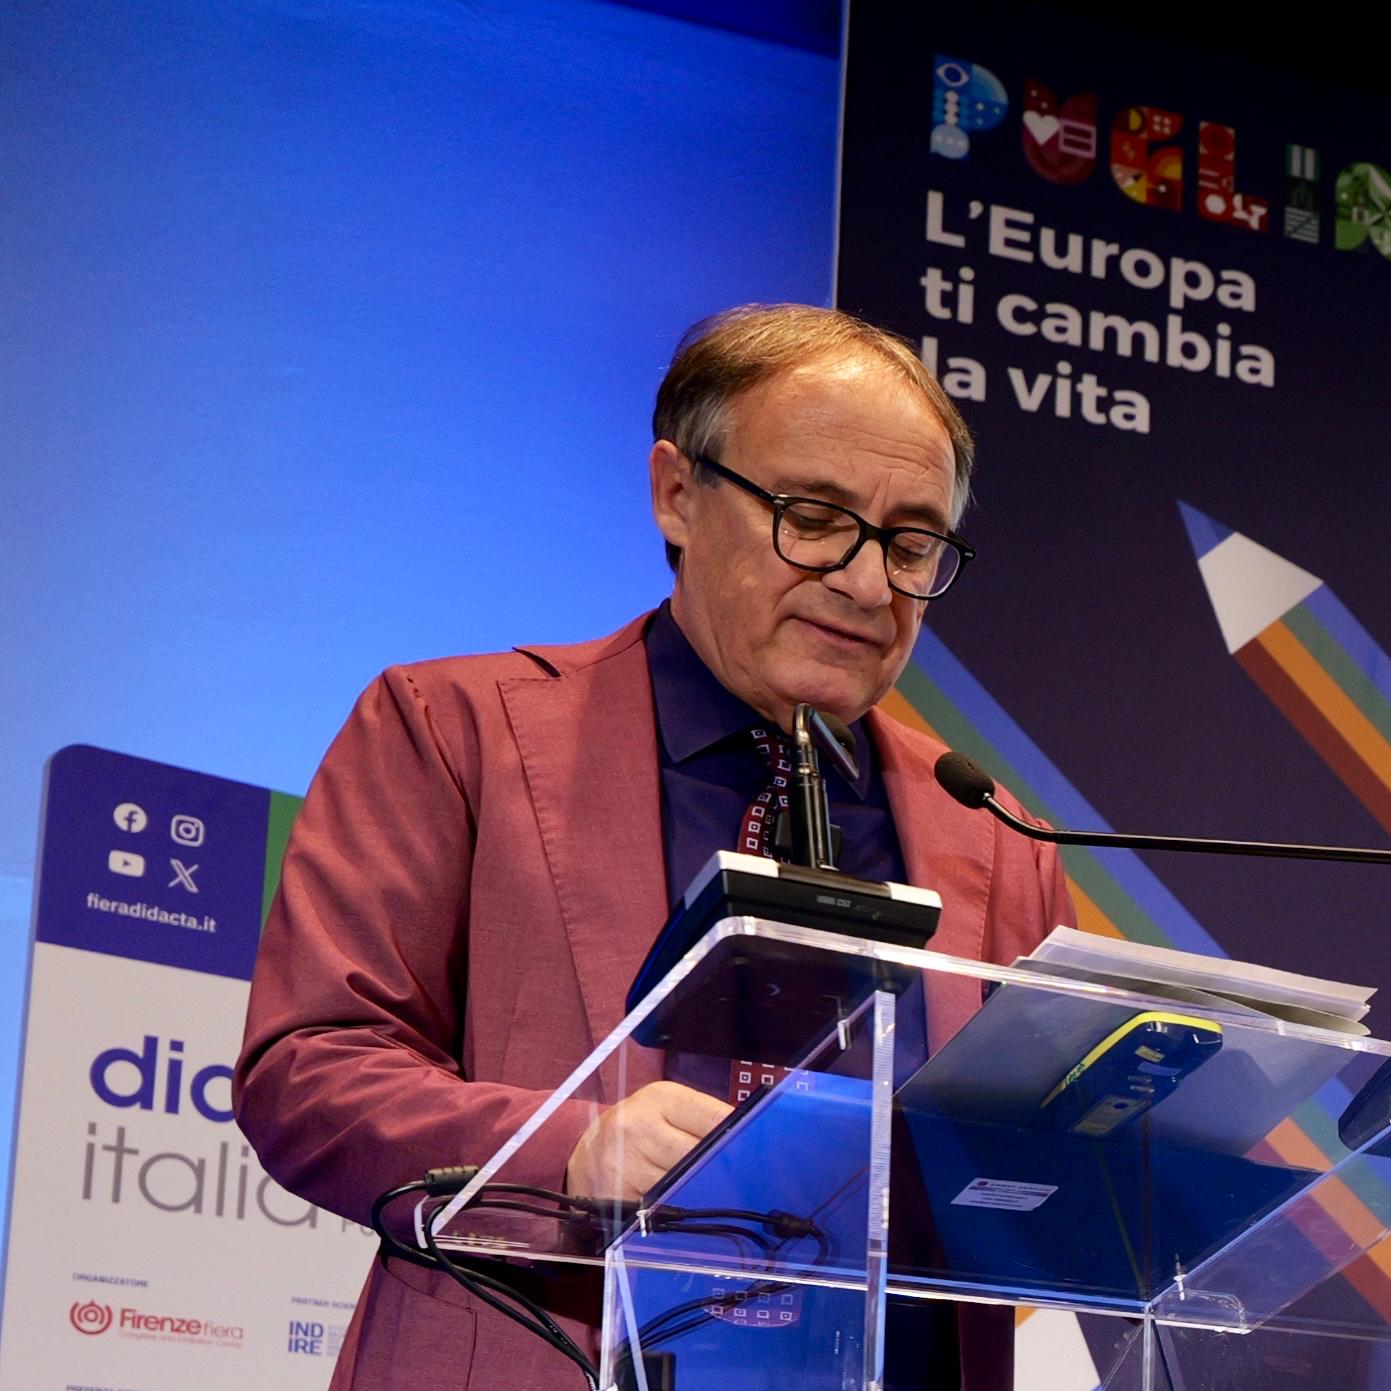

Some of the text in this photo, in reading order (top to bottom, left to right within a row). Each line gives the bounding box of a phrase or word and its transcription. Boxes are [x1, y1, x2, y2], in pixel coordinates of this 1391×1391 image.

[925, 190, 1256, 311] L'Europa
[920, 267, 1275, 388] ti cambia
[921, 337, 1151, 434] la vita
[87, 893, 216, 933] fieradidacta.it
[82, 1122, 317, 1229] italia
